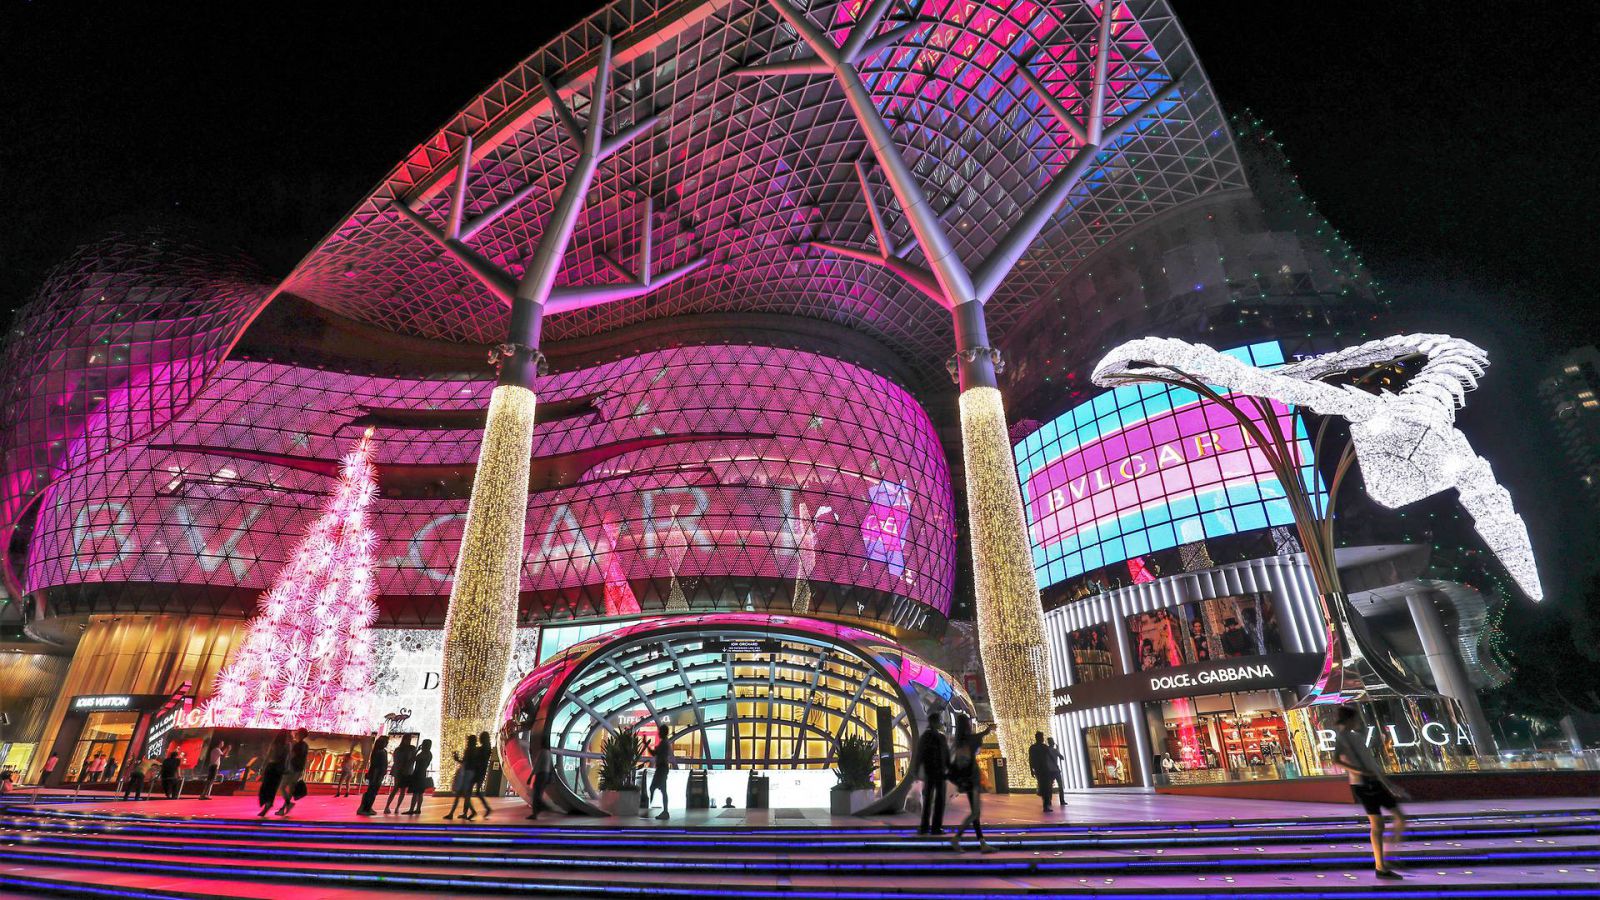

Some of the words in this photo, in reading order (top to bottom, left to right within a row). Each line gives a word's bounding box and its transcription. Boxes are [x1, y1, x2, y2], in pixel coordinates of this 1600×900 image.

[1046, 421, 1254, 513] BVLGARI
[1150, 674, 1191, 691] DOLCE
[1197, 664, 1274, 684] GABBANA
[75, 697, 96, 707] LOUIS
[95, 696, 130, 707] VUITTON
